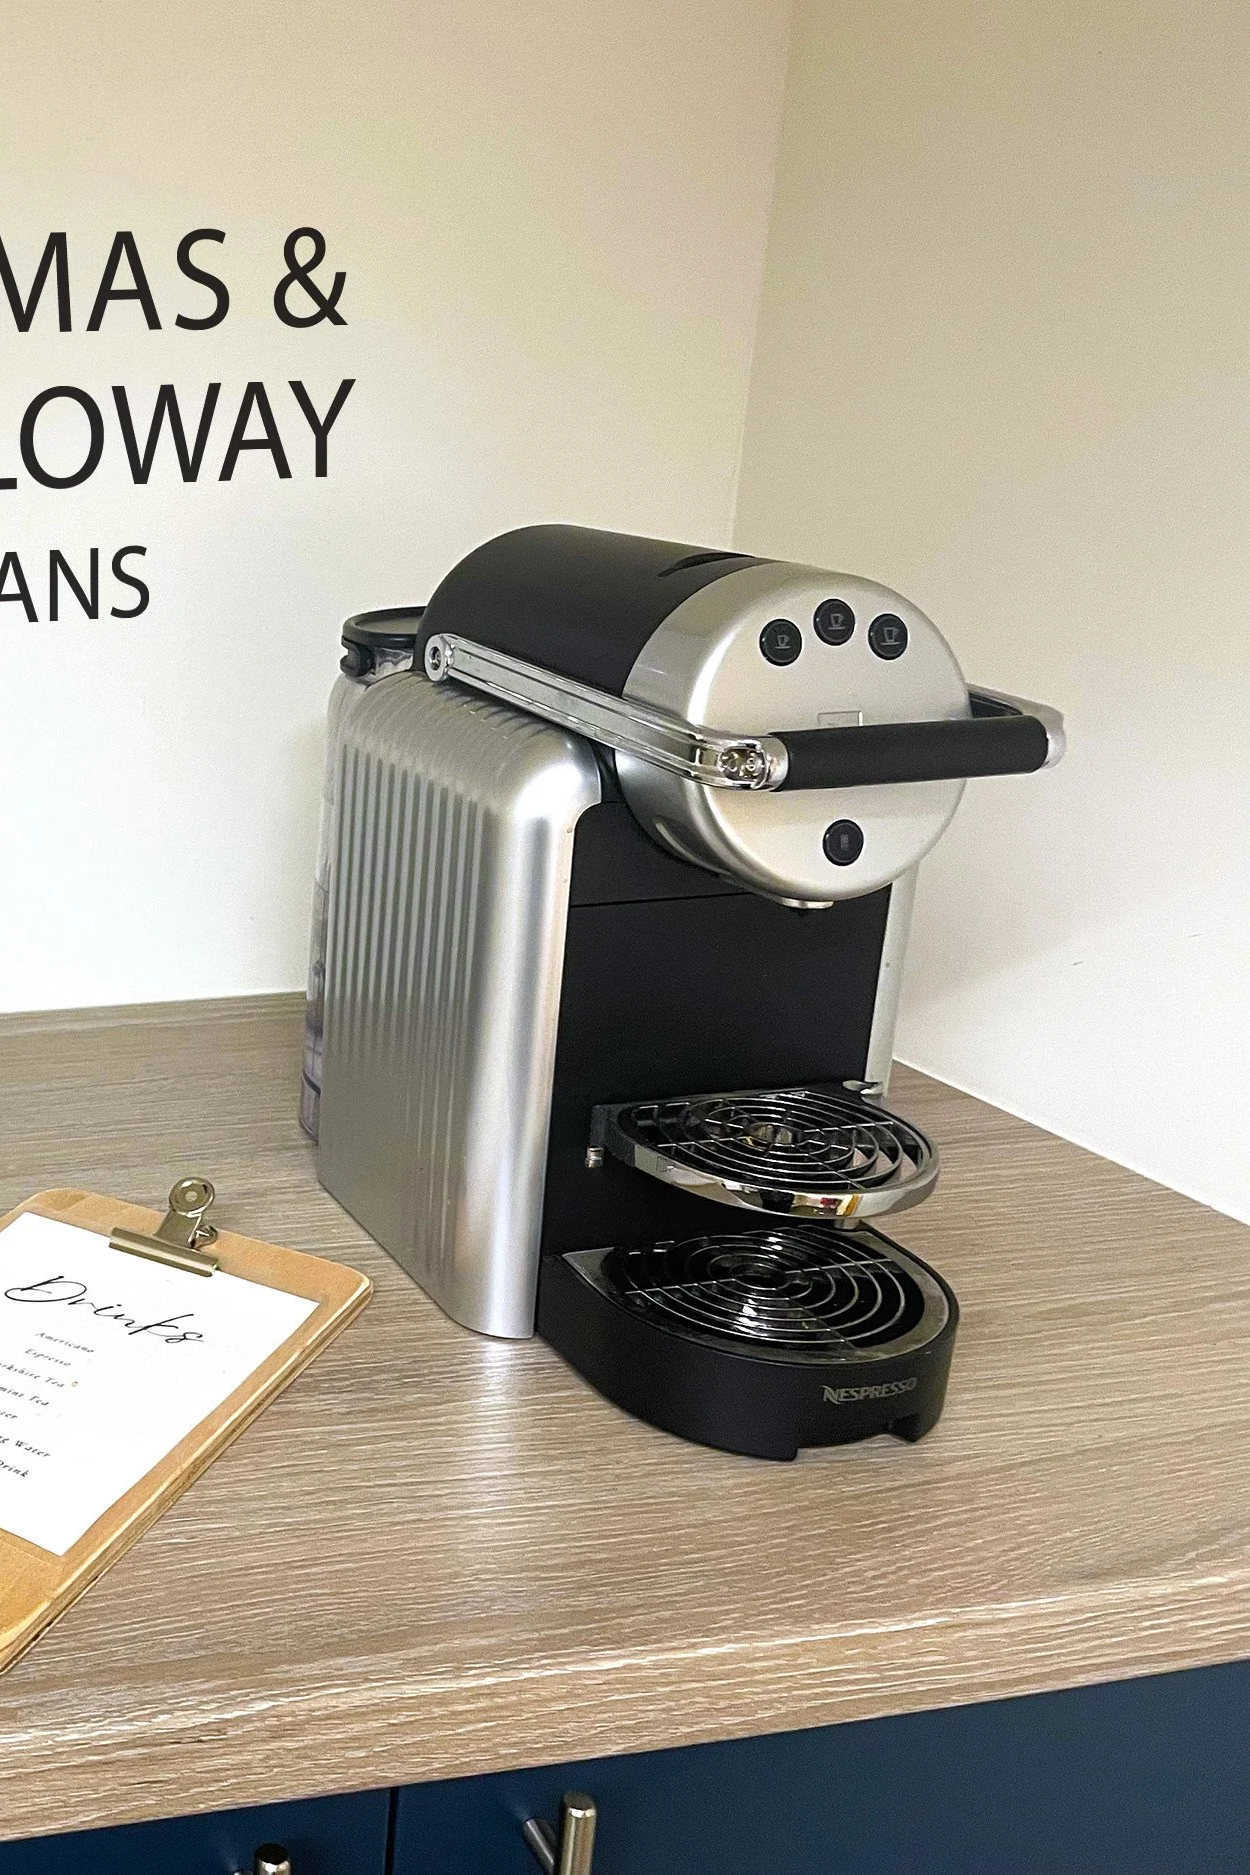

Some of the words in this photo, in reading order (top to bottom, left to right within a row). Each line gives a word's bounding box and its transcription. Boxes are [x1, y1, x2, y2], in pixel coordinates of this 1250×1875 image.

[273, 226, 349, 329] &
[4, 1275, 204, 1344] Drinks
[34, 1332, 95, 1353] Americano
[25, 1348, 71, 1367] Espresso
[44, 1377, 65, 1388] Tea
[819, 1377, 918, 1405] NESPRESSO
[29, 1395, 50, 1406] Tea
[15, 1440, 51, 1458] Water
